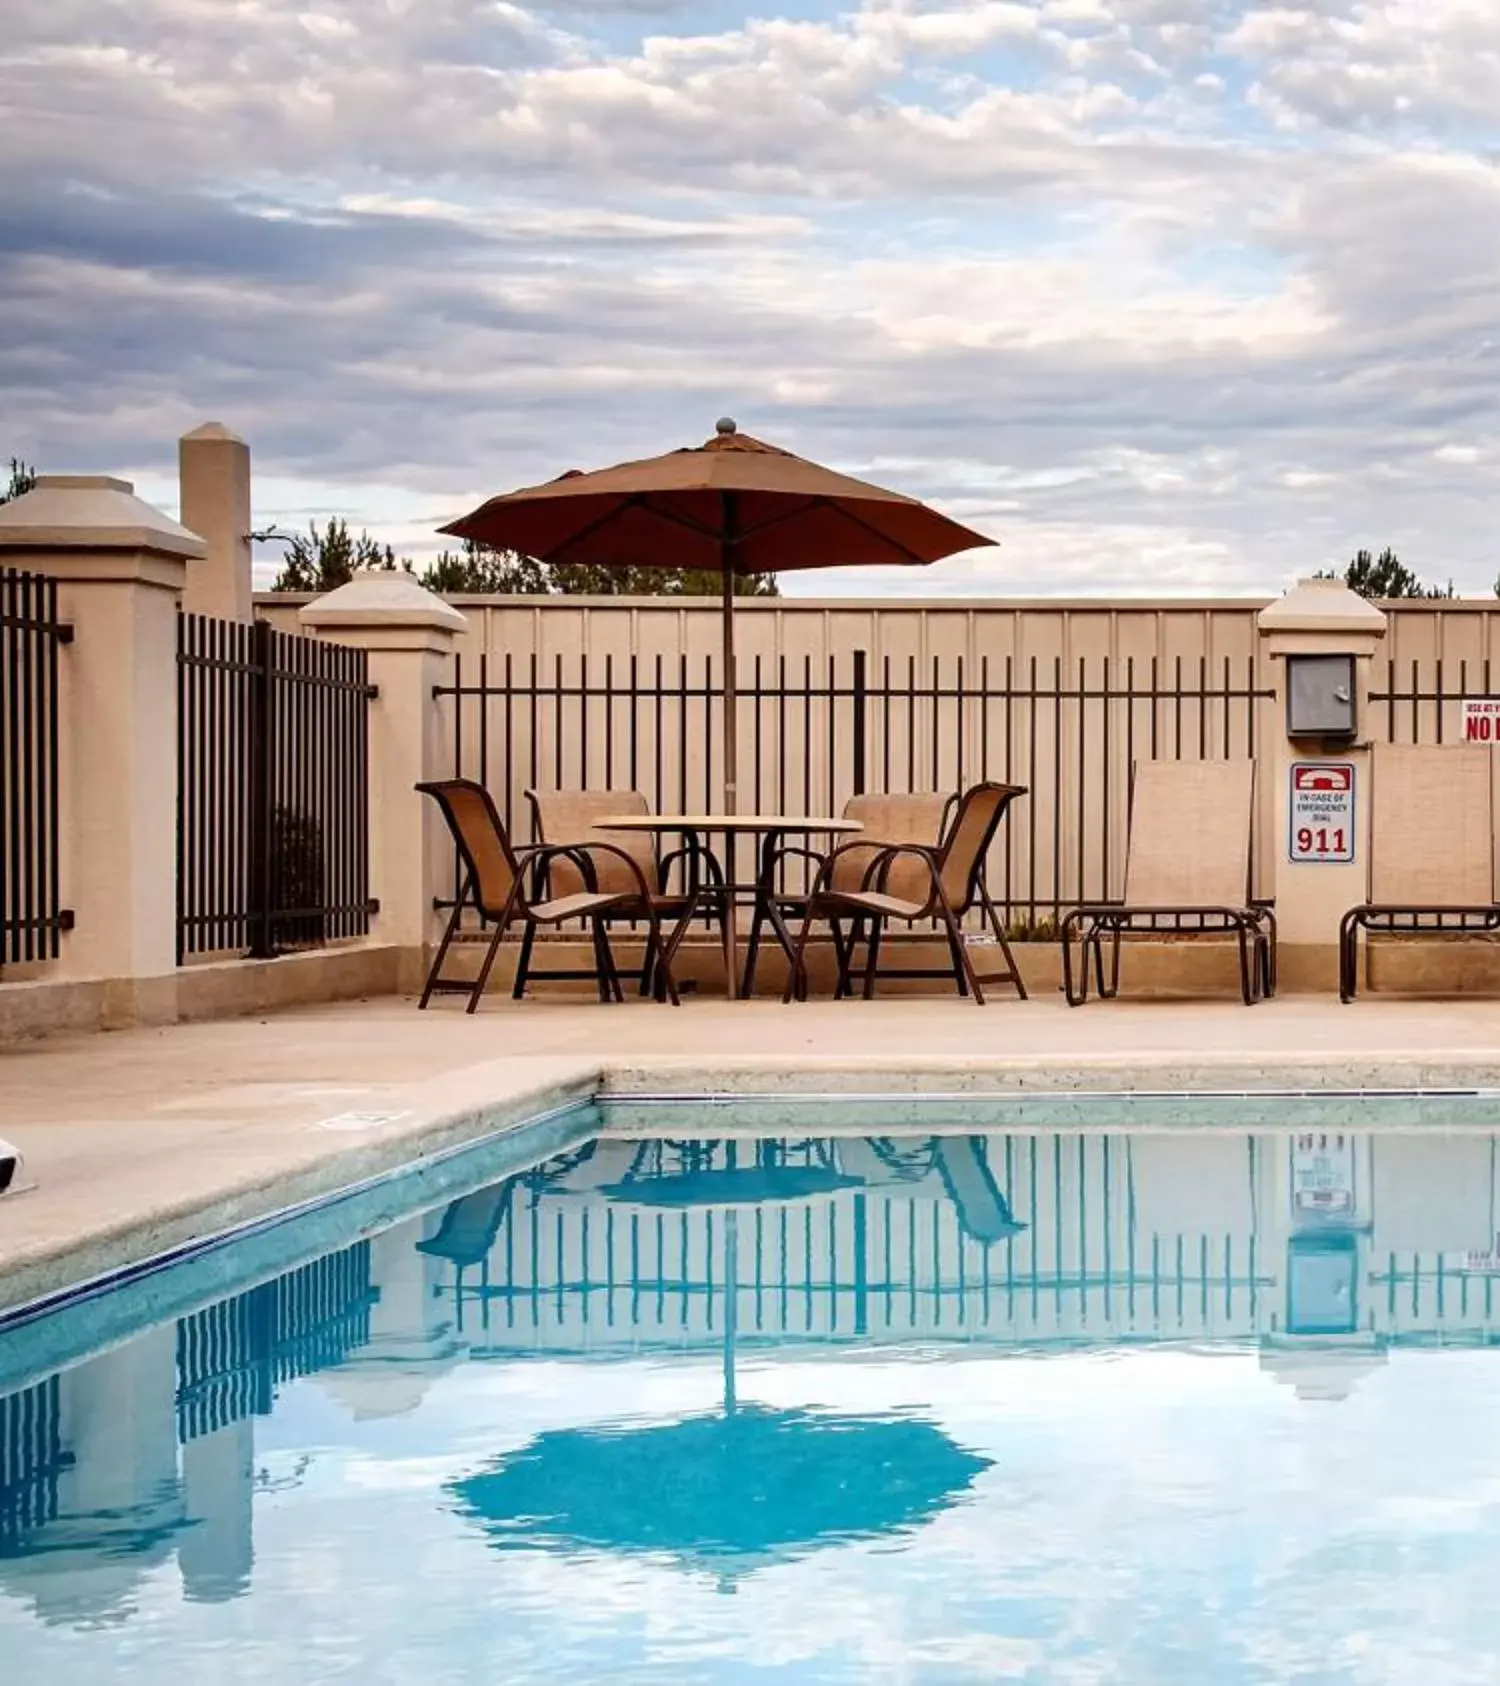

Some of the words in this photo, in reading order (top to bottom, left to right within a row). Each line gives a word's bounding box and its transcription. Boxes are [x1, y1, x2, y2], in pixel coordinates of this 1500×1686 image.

[1467, 703, 1482, 712] USE
[1466, 716, 1491, 741] NO
[1299, 793, 1309, 802] IN
[1311, 793, 1332, 802] CASE
[1333, 793, 1344, 802] OF
[1297, 804, 1347, 812] EMERGENCY
[1297, 827, 1347, 853] 911
